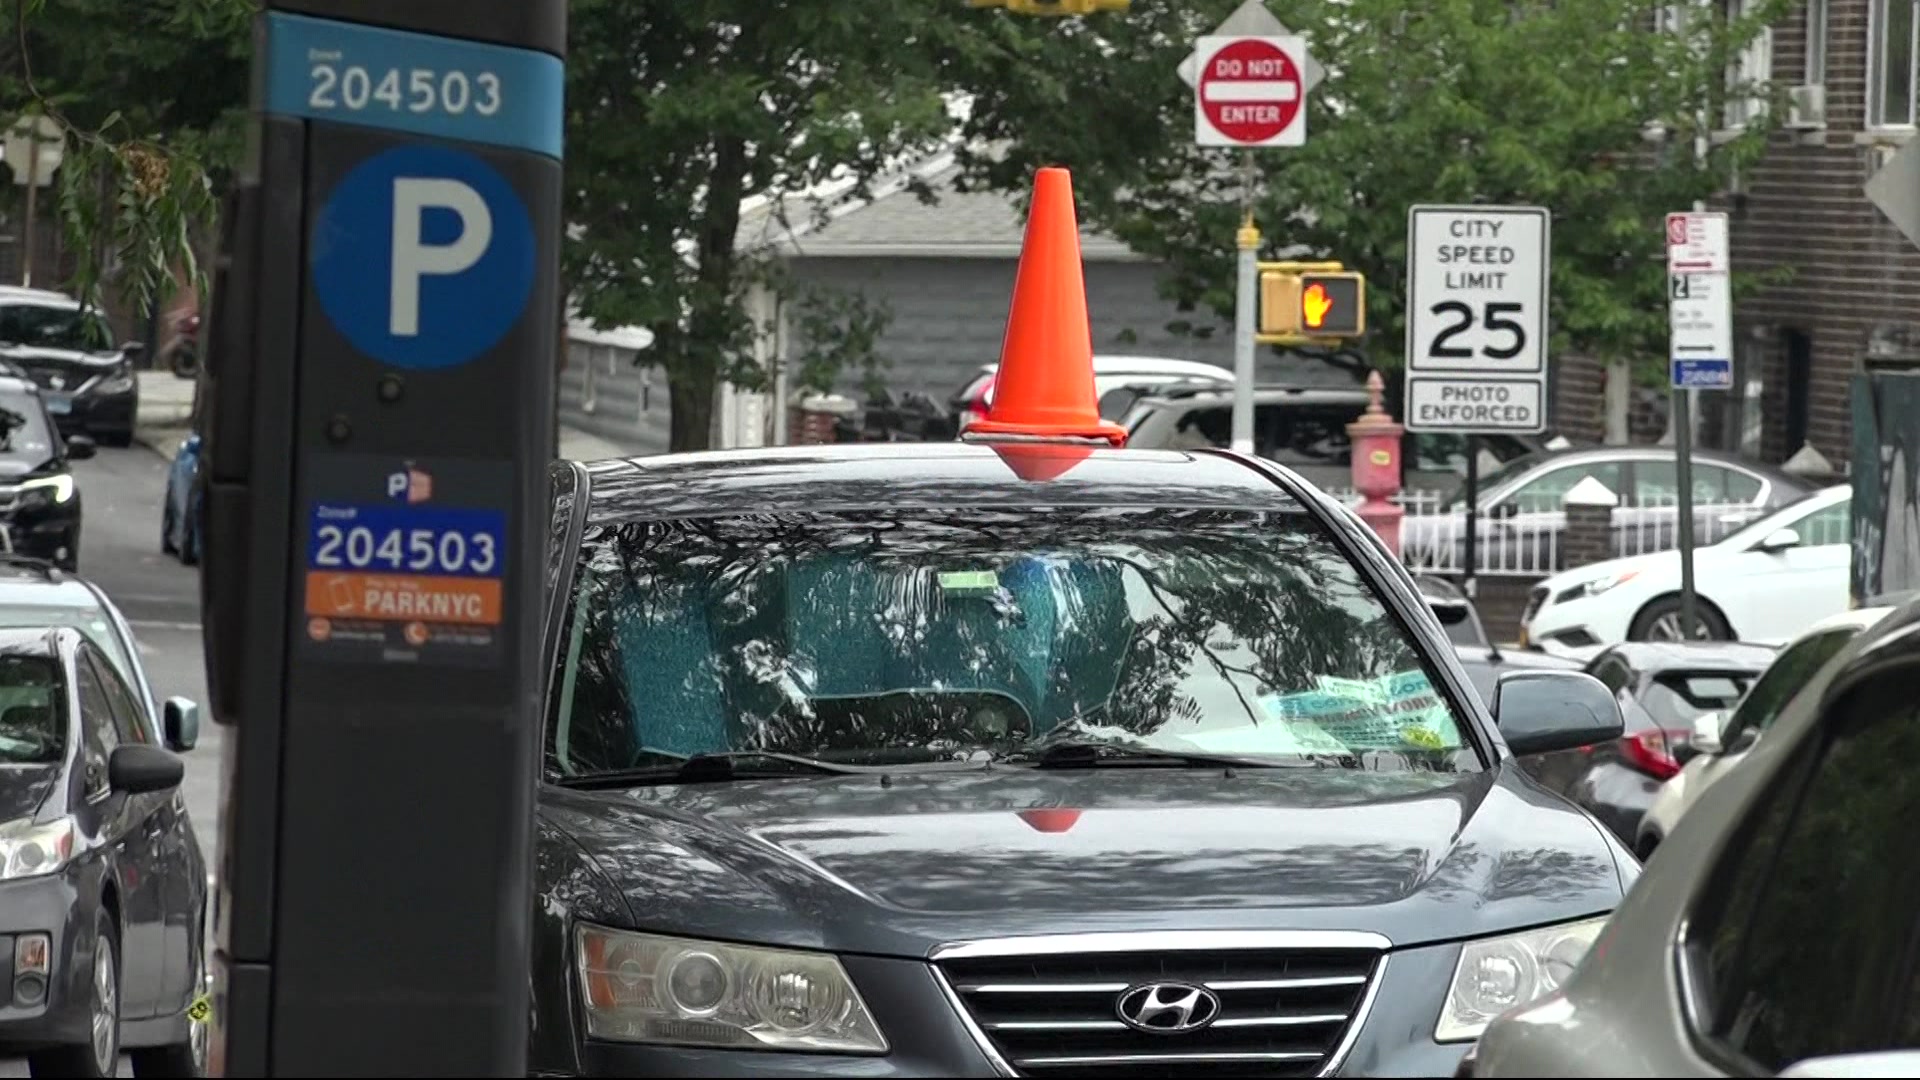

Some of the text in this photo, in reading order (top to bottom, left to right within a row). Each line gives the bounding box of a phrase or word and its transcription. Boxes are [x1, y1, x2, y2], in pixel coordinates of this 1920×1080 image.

[1216, 59, 1285, 76] DO NOT
[309, 65, 500, 115] 204503
[1220, 106, 1280, 124] ENTER
[1450, 220, 1504, 238] CITY
[390, 177, 492, 336] P
[1438, 245, 1515, 264] SPEED
[1446, 272, 1508, 290] LIMIT
[1428, 300, 1526, 359] 25
[1441, 386, 1510, 402] PHOTO
[1420, 404, 1531, 422] ENFORCED
[316, 525, 495, 573] 204503
[364, 589, 482, 617] PARKNYC
